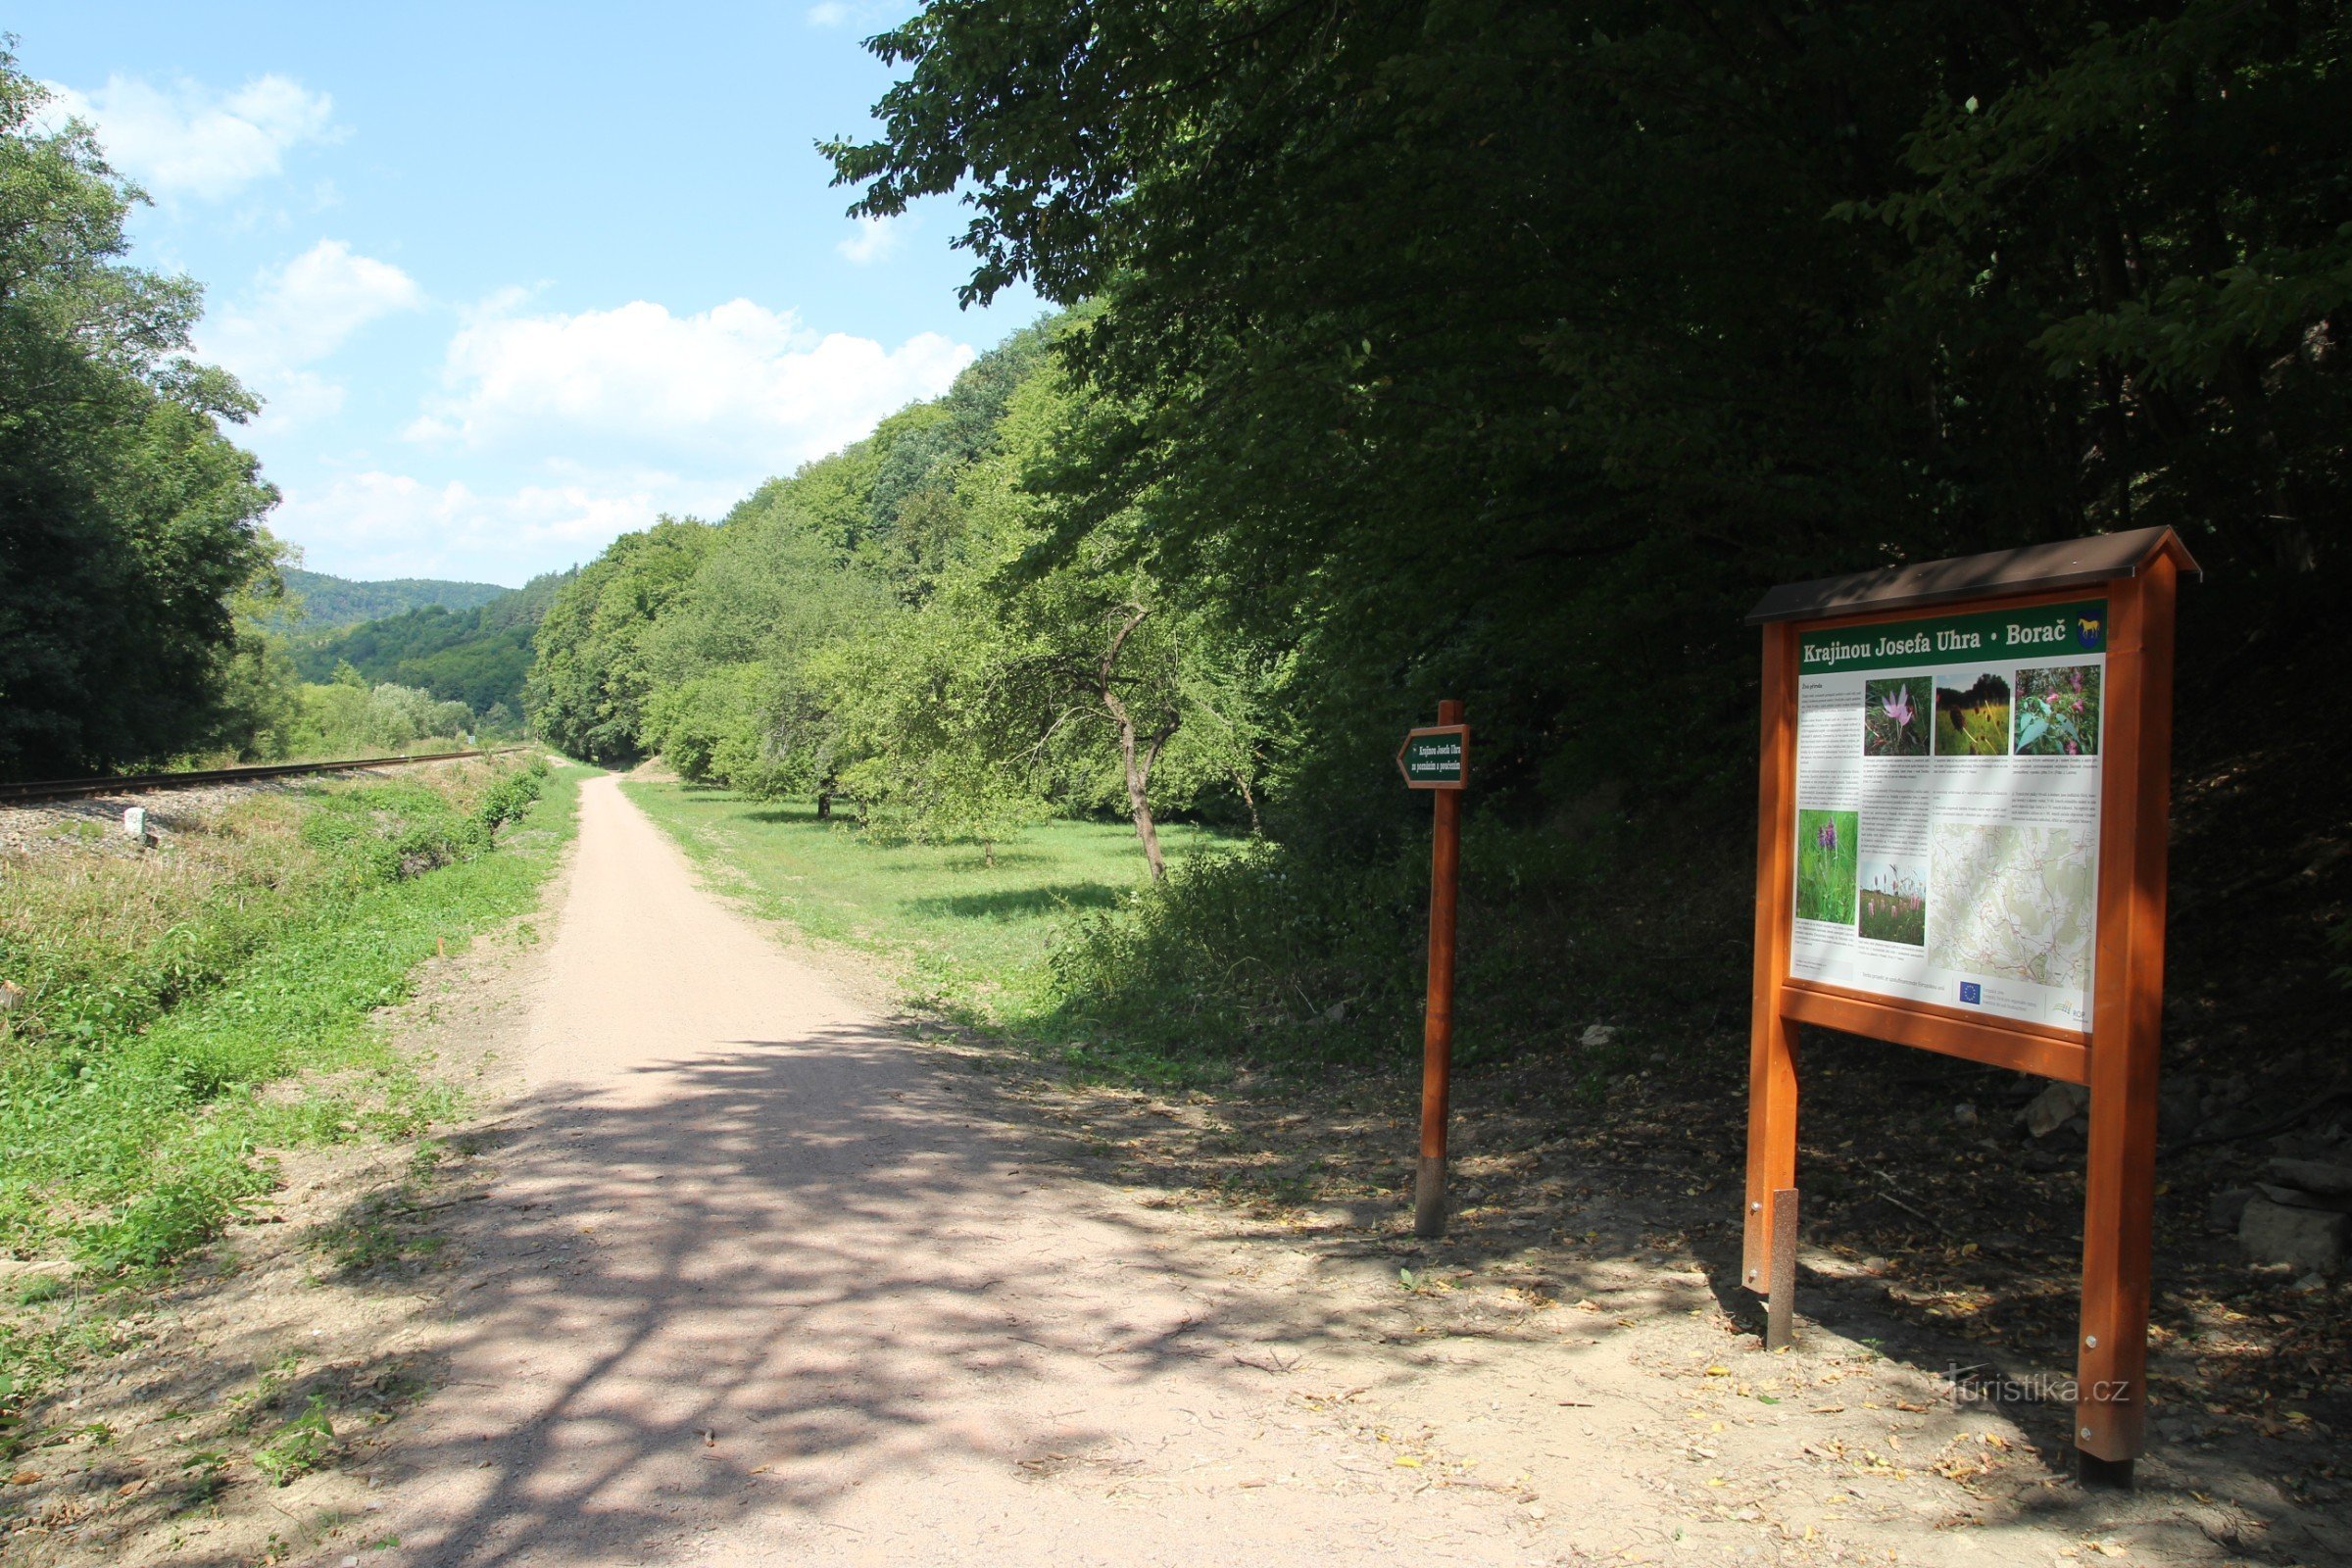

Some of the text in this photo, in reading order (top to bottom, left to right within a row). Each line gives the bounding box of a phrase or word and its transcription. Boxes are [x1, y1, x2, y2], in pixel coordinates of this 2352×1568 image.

[1803, 619, 2066, 665] Krajinou Josefa Uhra Borač
[1451, 744, 1461, 755] Uhra
